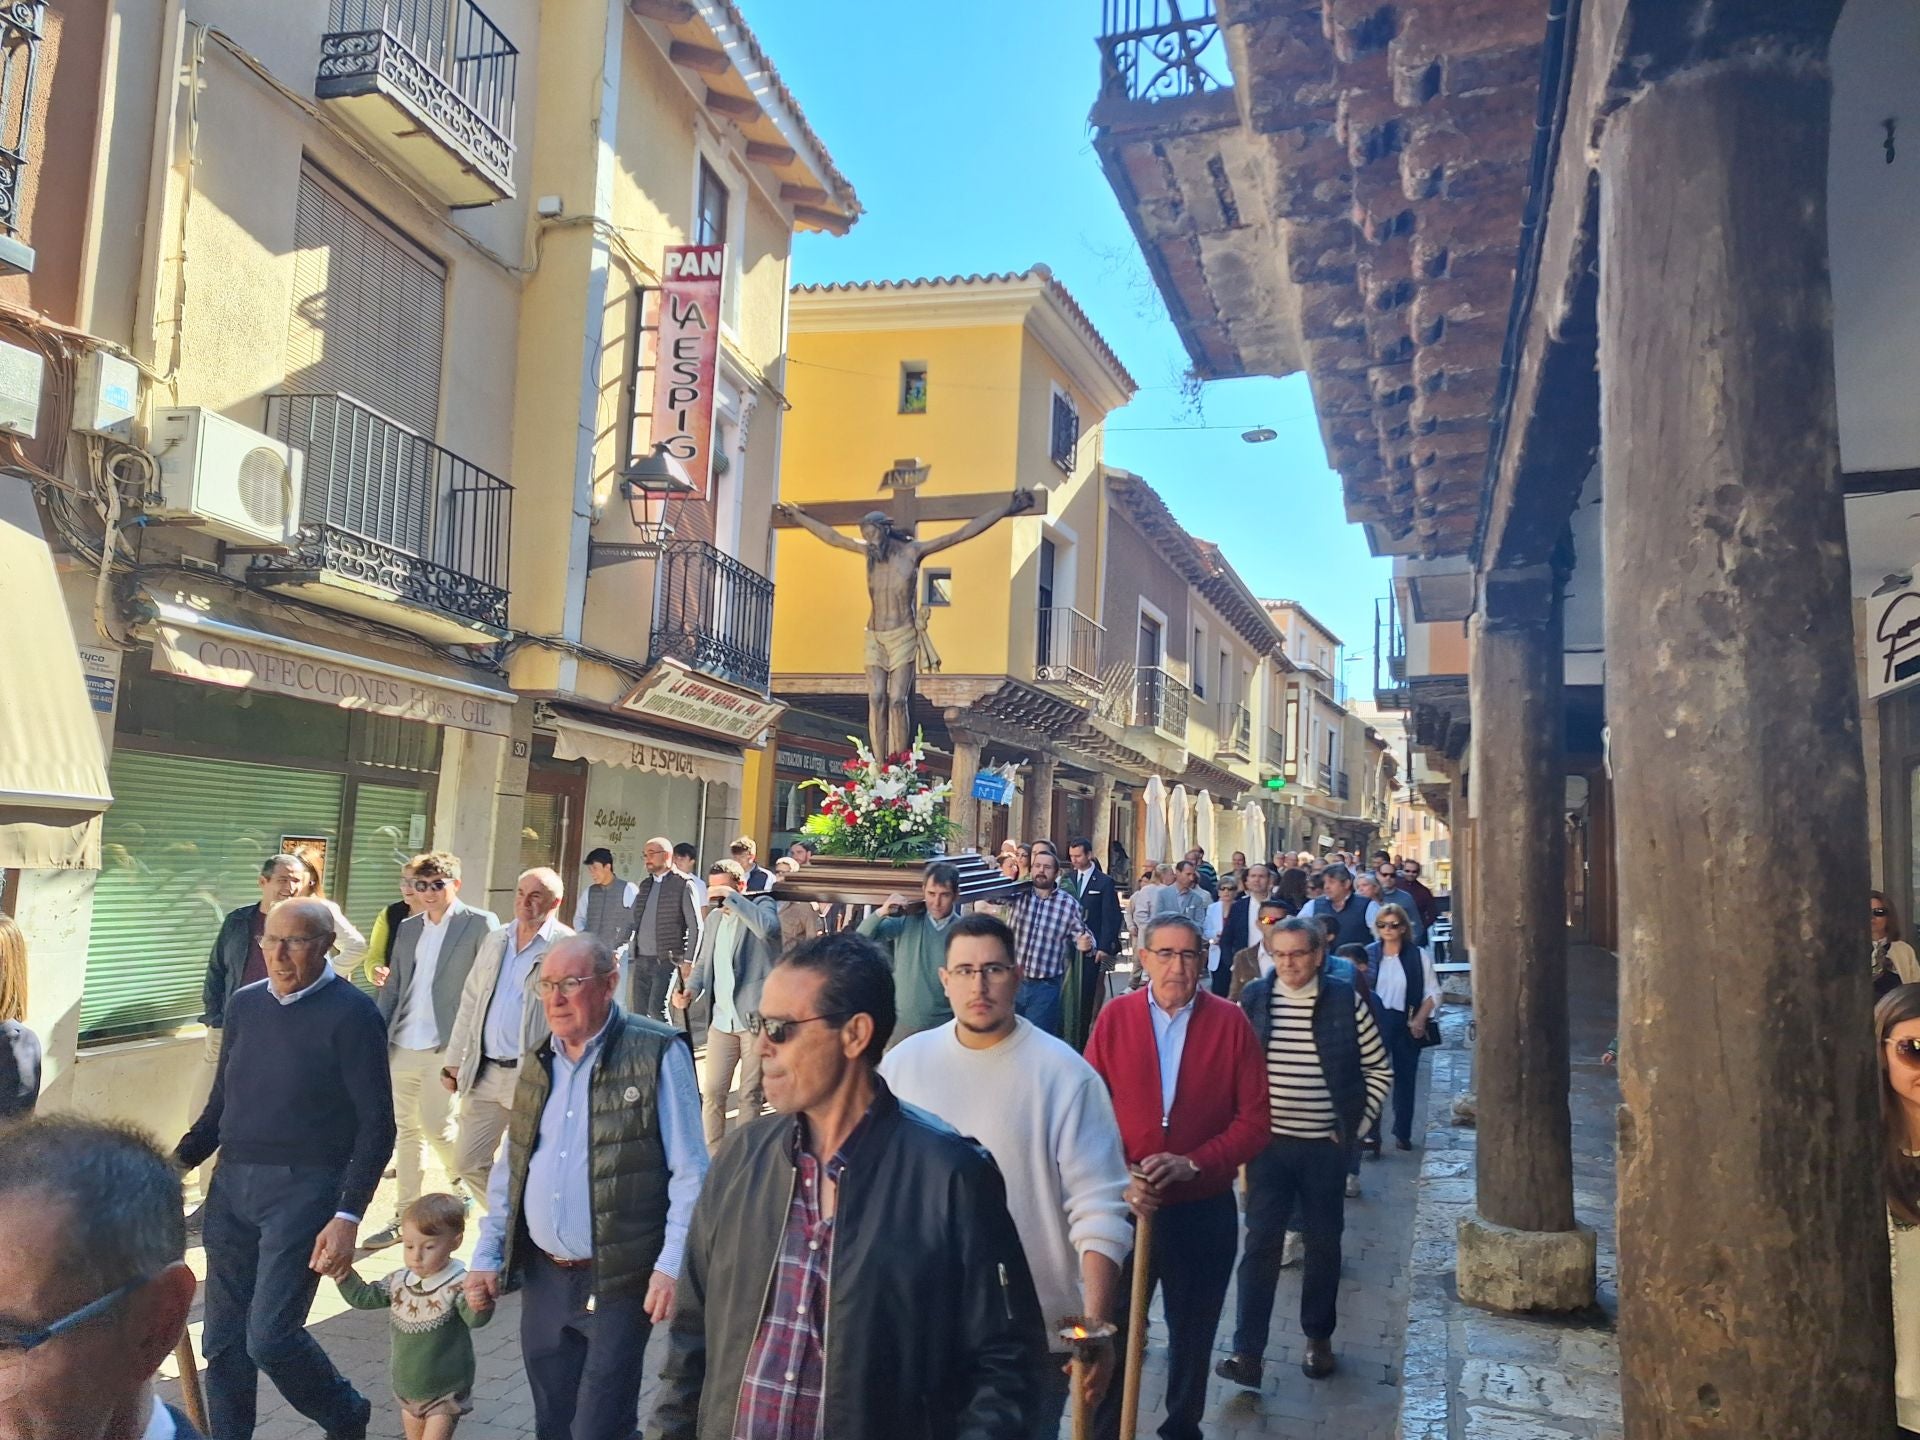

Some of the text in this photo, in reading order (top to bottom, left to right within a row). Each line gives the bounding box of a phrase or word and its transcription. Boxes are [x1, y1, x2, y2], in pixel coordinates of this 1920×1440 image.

[664, 251, 721, 277] PAN
[671, 295, 707, 331] LA
[666, 336, 701, 460] ESPIG
[79, 651, 105, 663] tyco
[198, 641, 399, 707] CONFECCIONES
[461, 700, 492, 727] GIL
[514, 742, 525, 756] 30
[631, 743, 694, 774] LA ESPIGA
[594, 808, 637, 832] La Espiga
